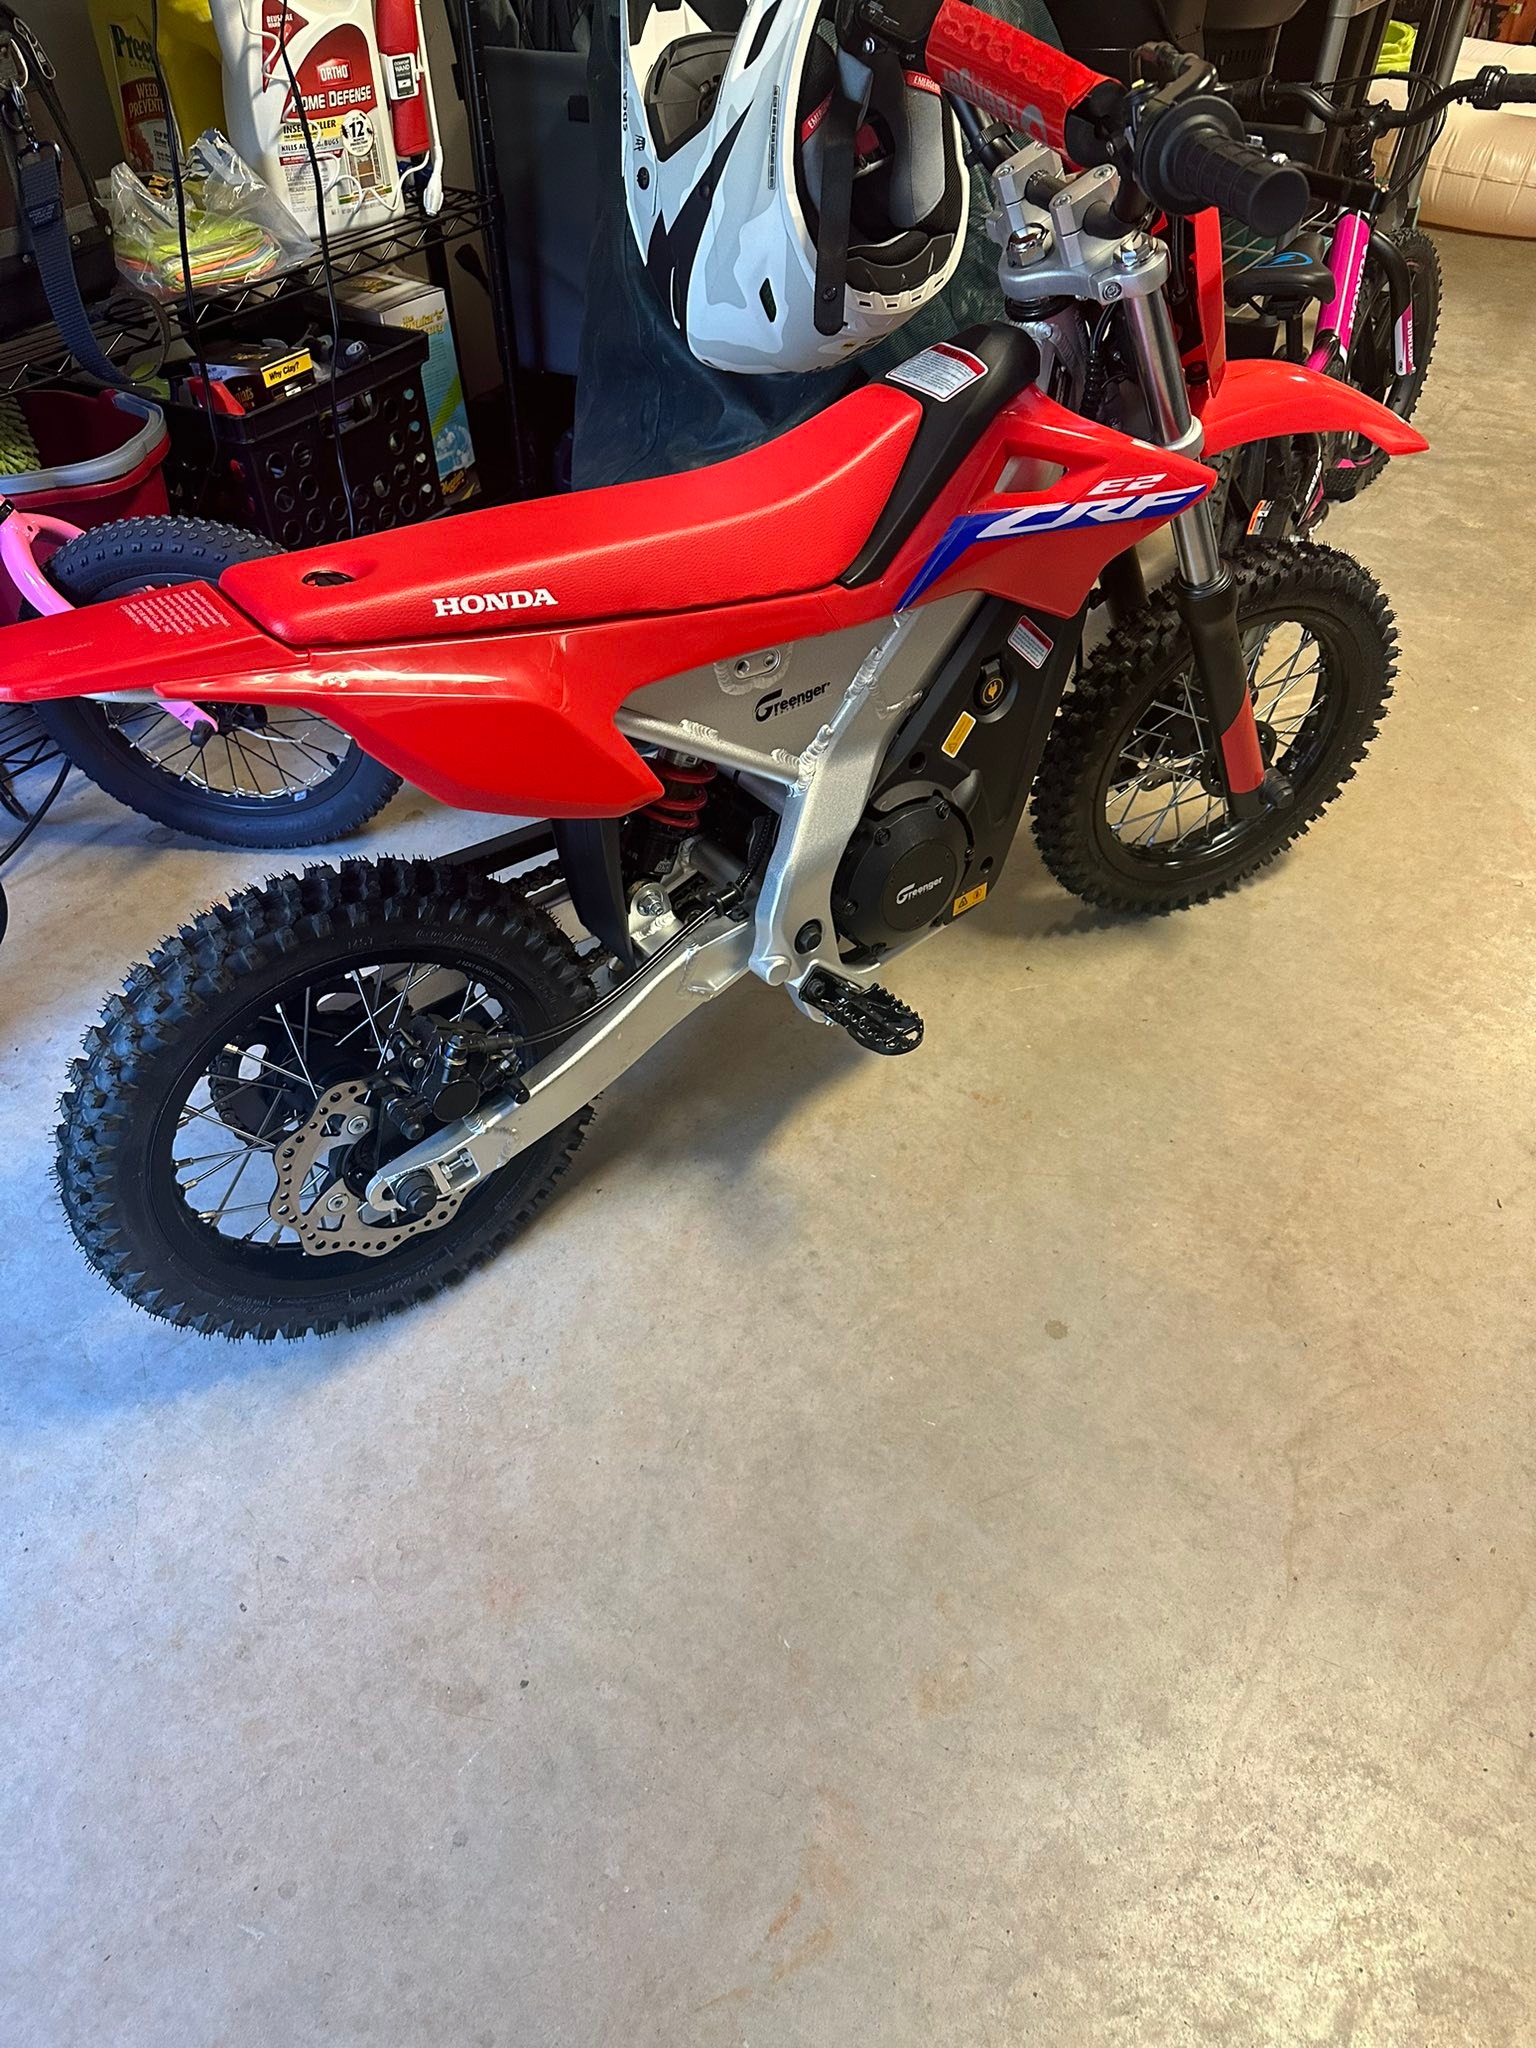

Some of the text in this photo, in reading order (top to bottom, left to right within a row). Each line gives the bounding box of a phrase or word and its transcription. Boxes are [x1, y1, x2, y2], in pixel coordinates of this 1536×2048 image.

[110, 24, 155, 62] Pree
[320, 64, 349, 82] ORTHO
[395, 64, 410, 72] WAND
[135, 83, 159, 100] WEED
[328, 85, 372, 108] DEFENSE
[283, 123, 303, 135] INSE
[349, 121, 365, 139] 12
[281, 144, 298, 153] KILLS
[324, 138, 340, 148] BUGS
[269, 361, 300, 381] Why Clay?
[1087, 473, 1168, 497] E2
[975, 484, 1208, 539] CRF
[433, 588, 558, 617] HONDA
[754, 682, 831, 723] Greenger
[896, 876, 944, 905] Greenger
